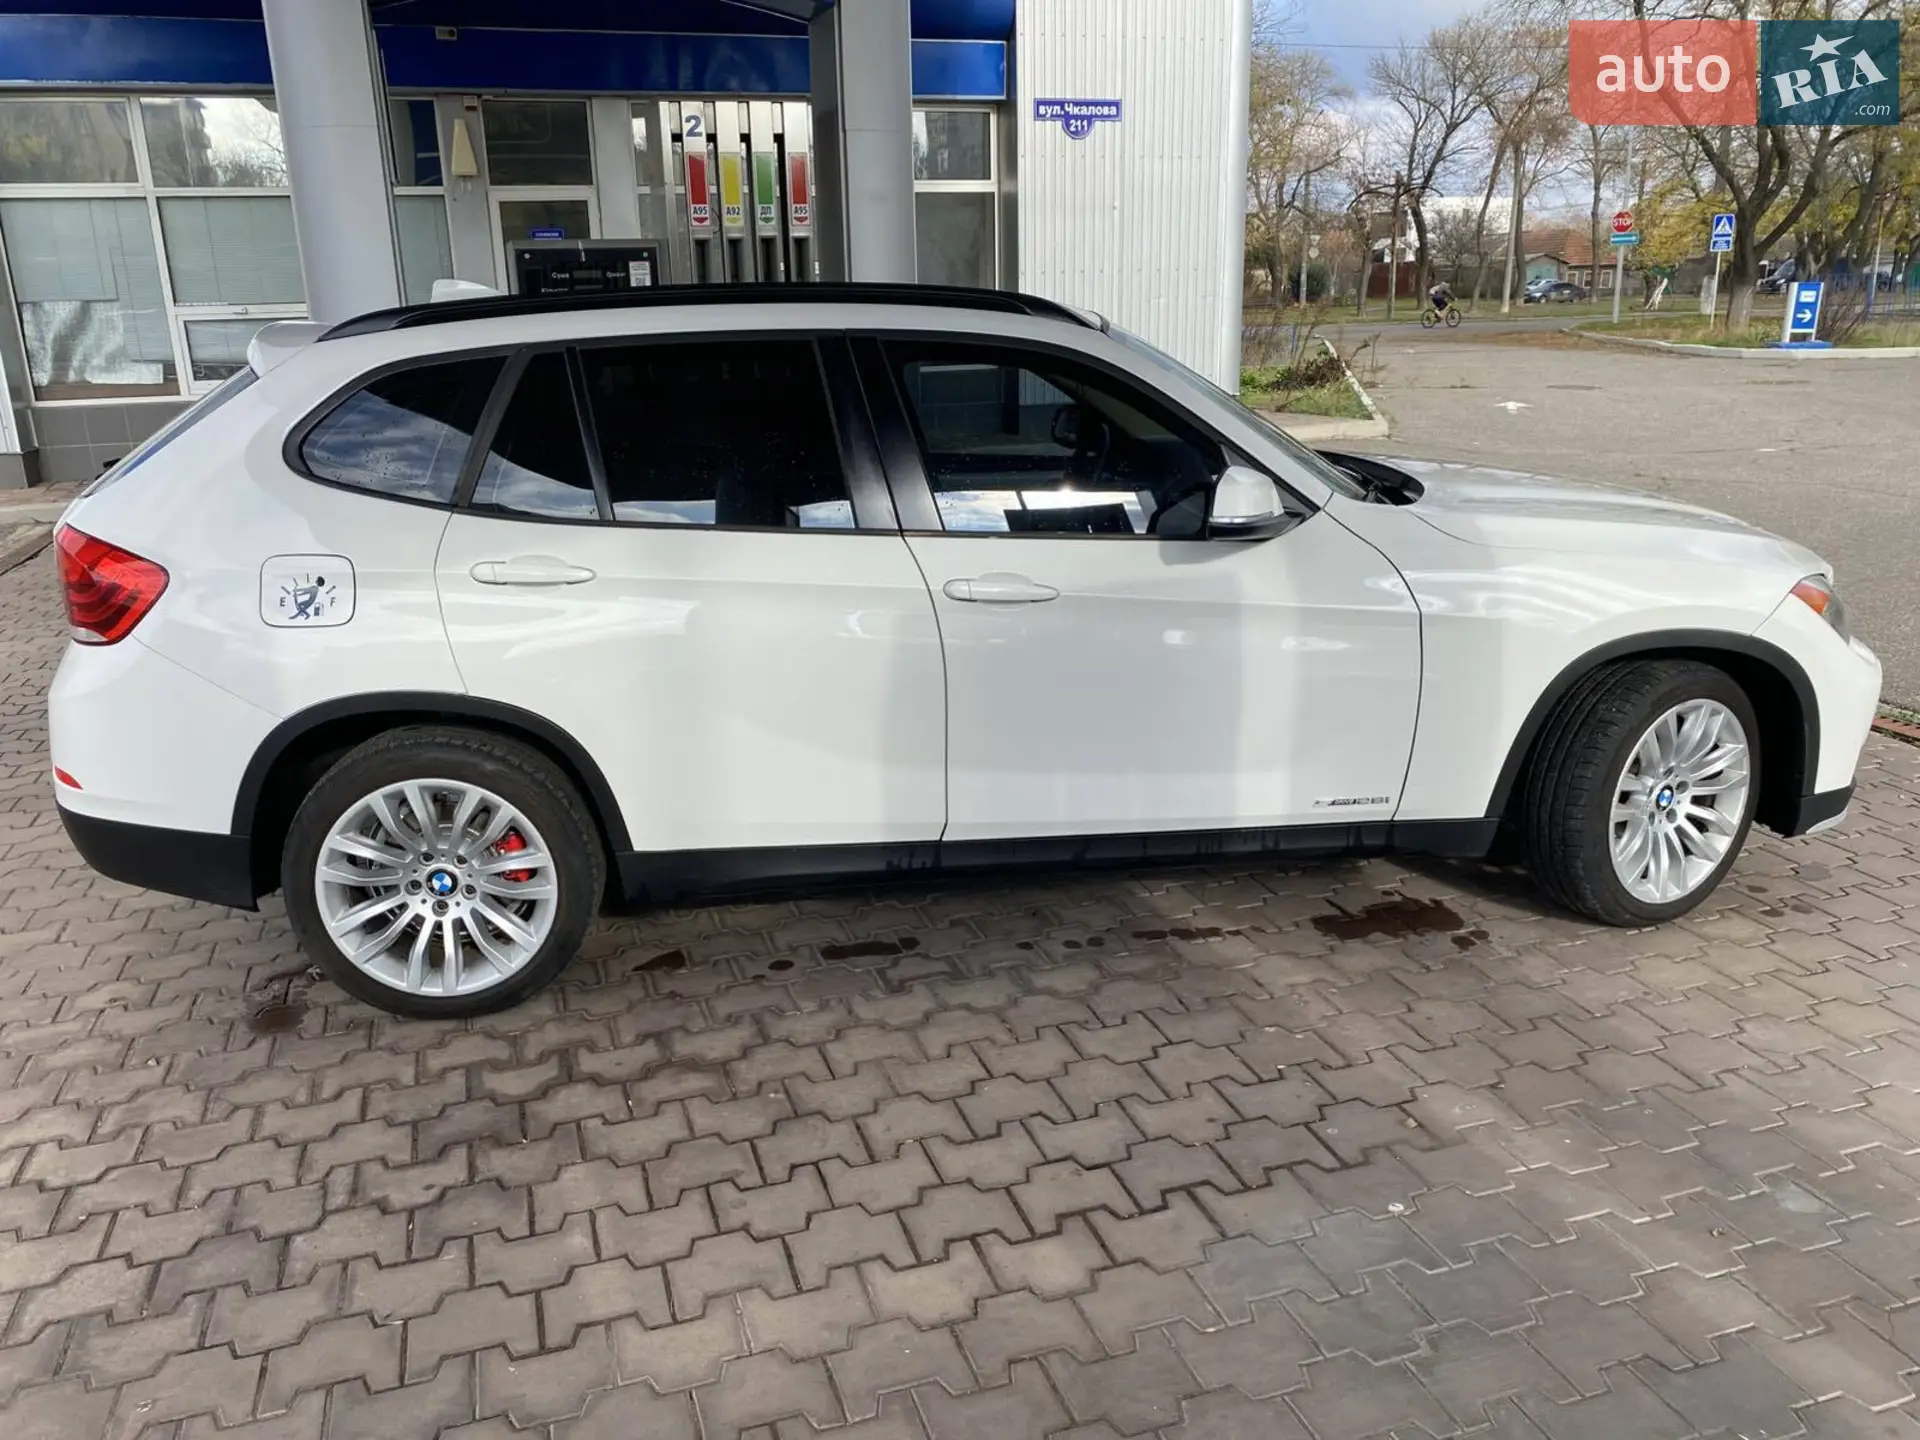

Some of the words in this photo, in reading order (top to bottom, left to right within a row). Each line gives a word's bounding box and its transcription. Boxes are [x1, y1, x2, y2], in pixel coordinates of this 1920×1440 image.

[684, 114, 703, 138] 2
[1069, 119, 1088, 132] 211
[280, 597, 286, 607] E
[330, 597, 336, 607] F
